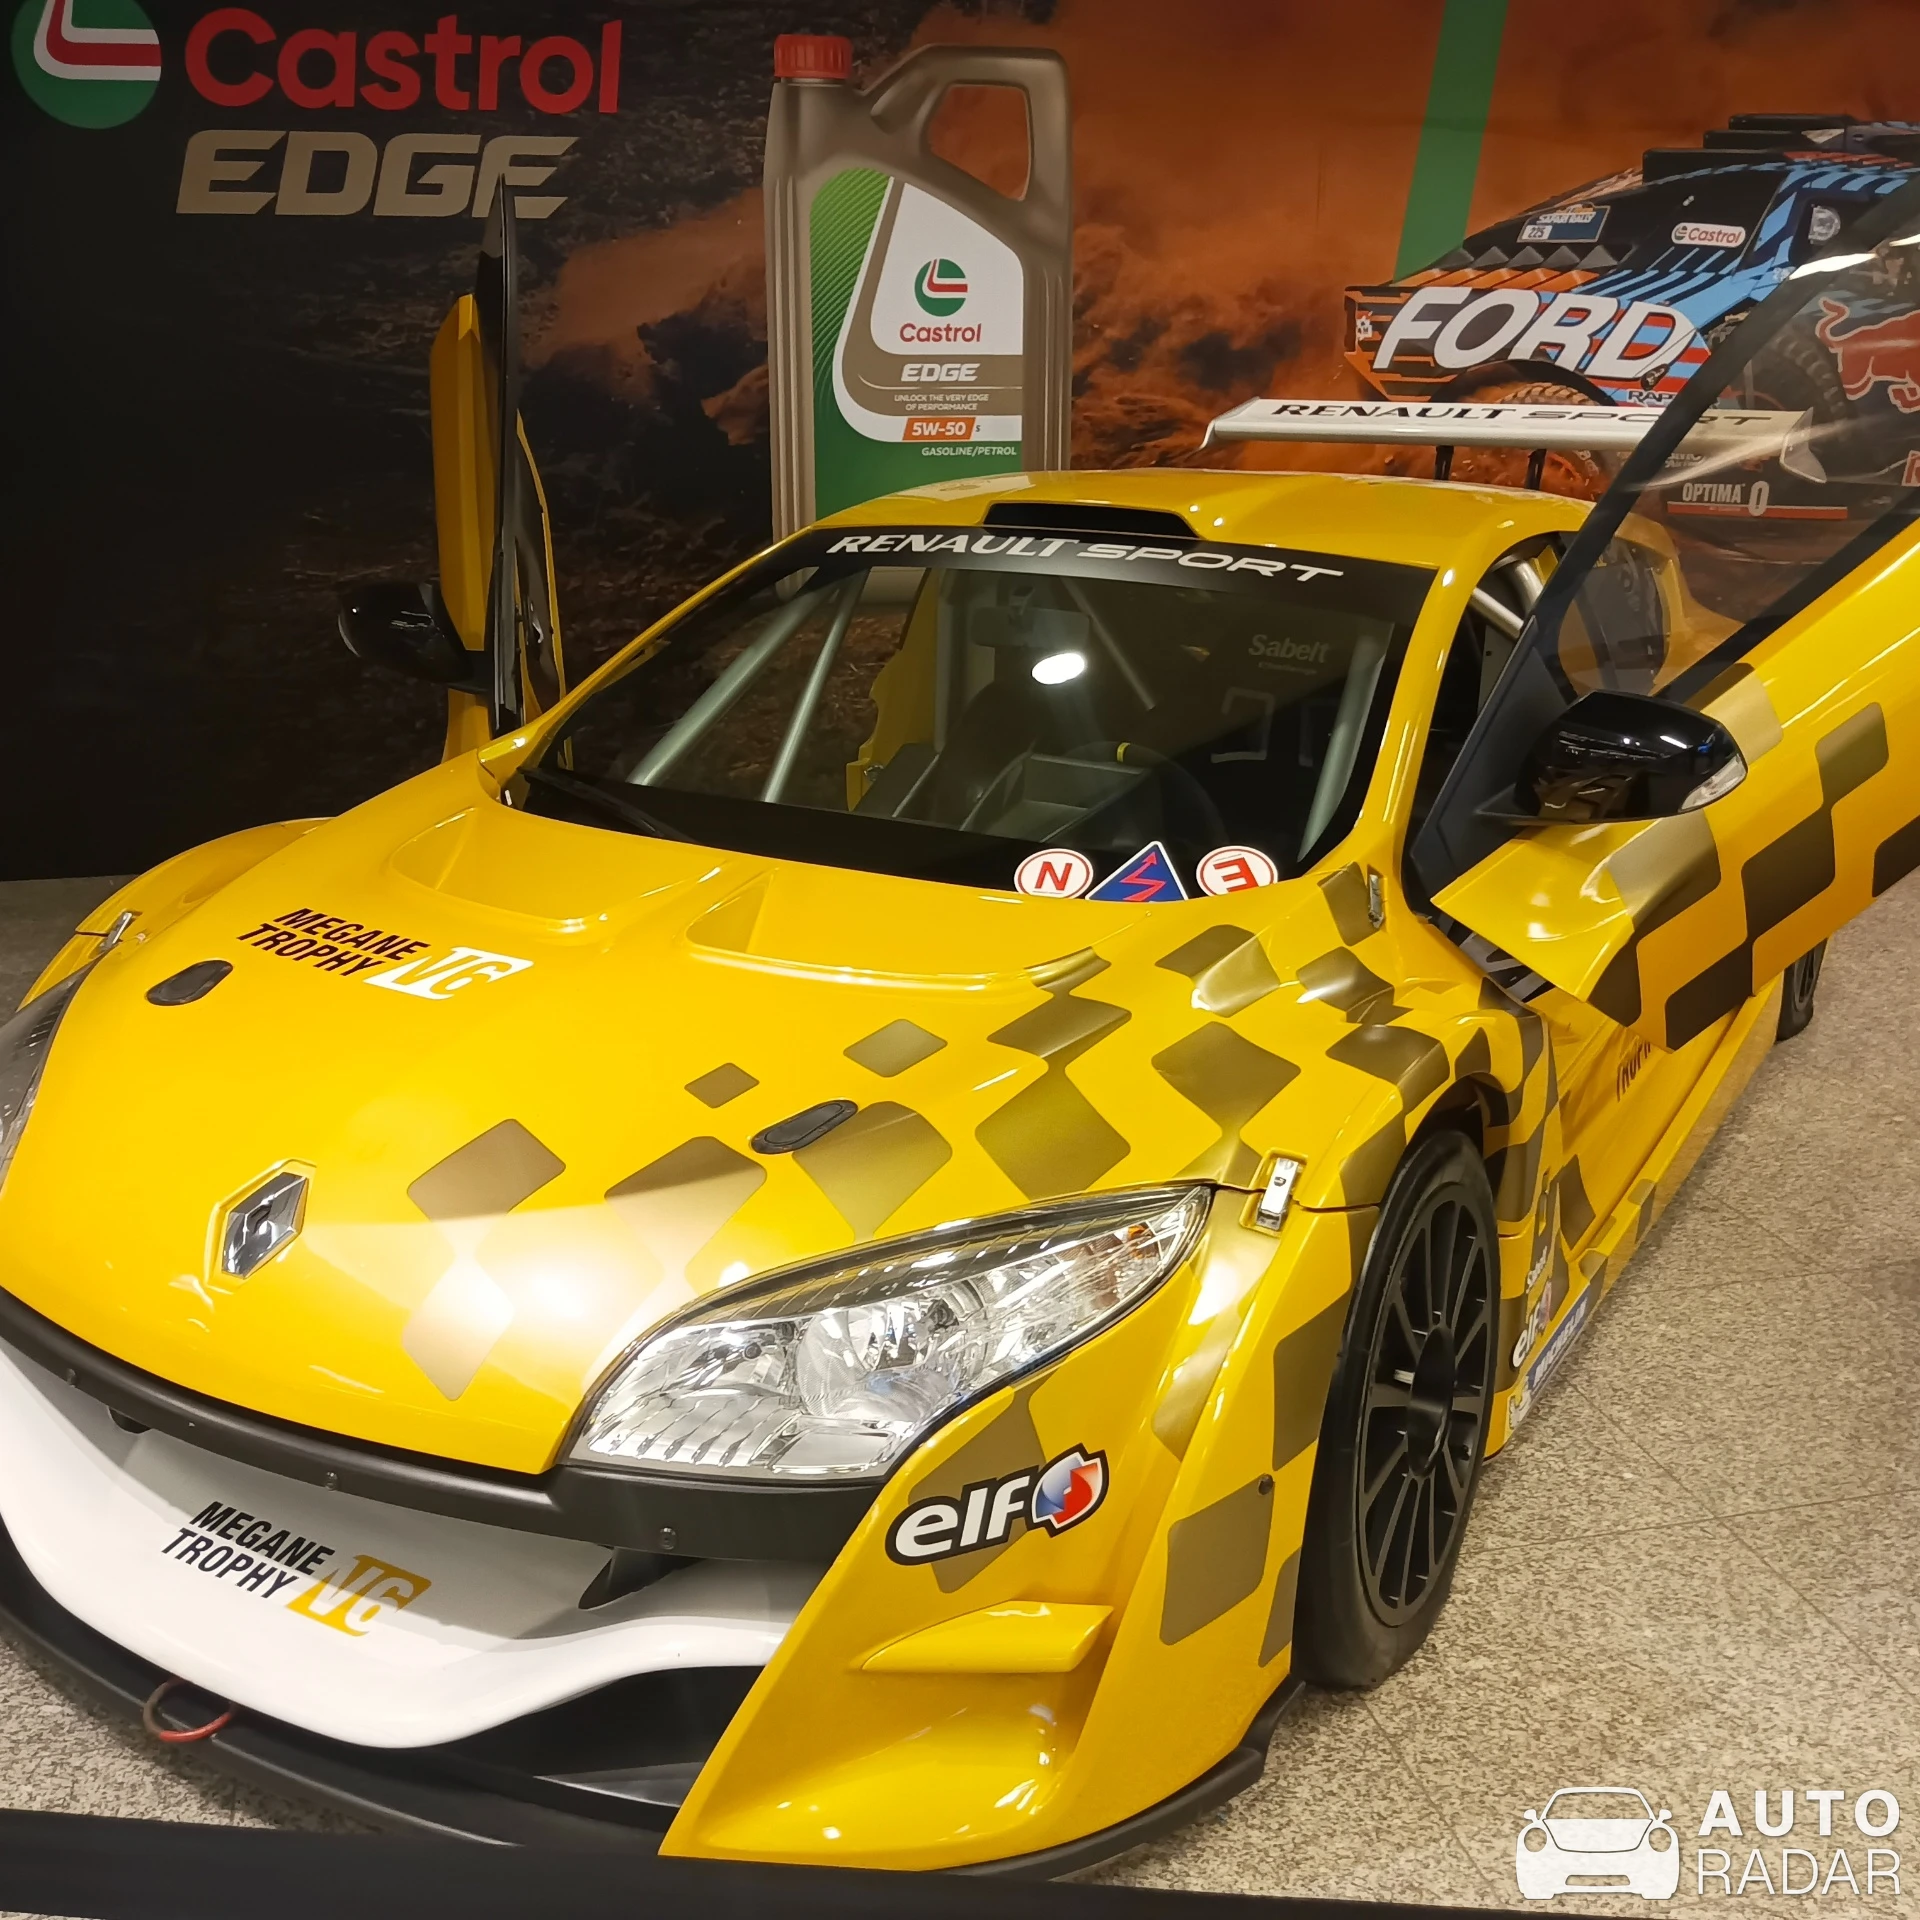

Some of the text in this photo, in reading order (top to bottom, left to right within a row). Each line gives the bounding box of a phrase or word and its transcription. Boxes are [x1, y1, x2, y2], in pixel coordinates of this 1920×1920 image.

[184, 7, 622, 114] Castrol
[175, 129, 580, 219] EDGE
[1687, 226, 1742, 245] Castrol
[899, 322, 982, 342] Castrol
[1372, 286, 1696, 379] FORD
[900, 363, 981, 382] EDGE
[894, 393, 990, 402] UNLOCK THE VERY EDGE
[905, 402, 978, 411] OF PERFORMANCE
[1271, 404, 1516, 419] RENAULT
[911, 421, 966, 436] 5W-50
[921, 445, 1018, 458] GASOLINE/PETROL
[1682, 482, 1742, 504] OPTIMA
[826, 534, 1344, 582] RENAULT SPORT
[1248, 634, 1330, 664] Sabelt
[1034, 861, 1073, 891] N
[236, 922, 386, 977] TROPHY
[273, 907, 432, 961] MEGANE
[362, 946, 534, 1000] V6
[894, 1474, 1031, 1558] elf
[188, 1501, 336, 1576] MEGANE
[161, 1527, 300, 1599] TROPHY
[285, 1554, 433, 1637] V6
